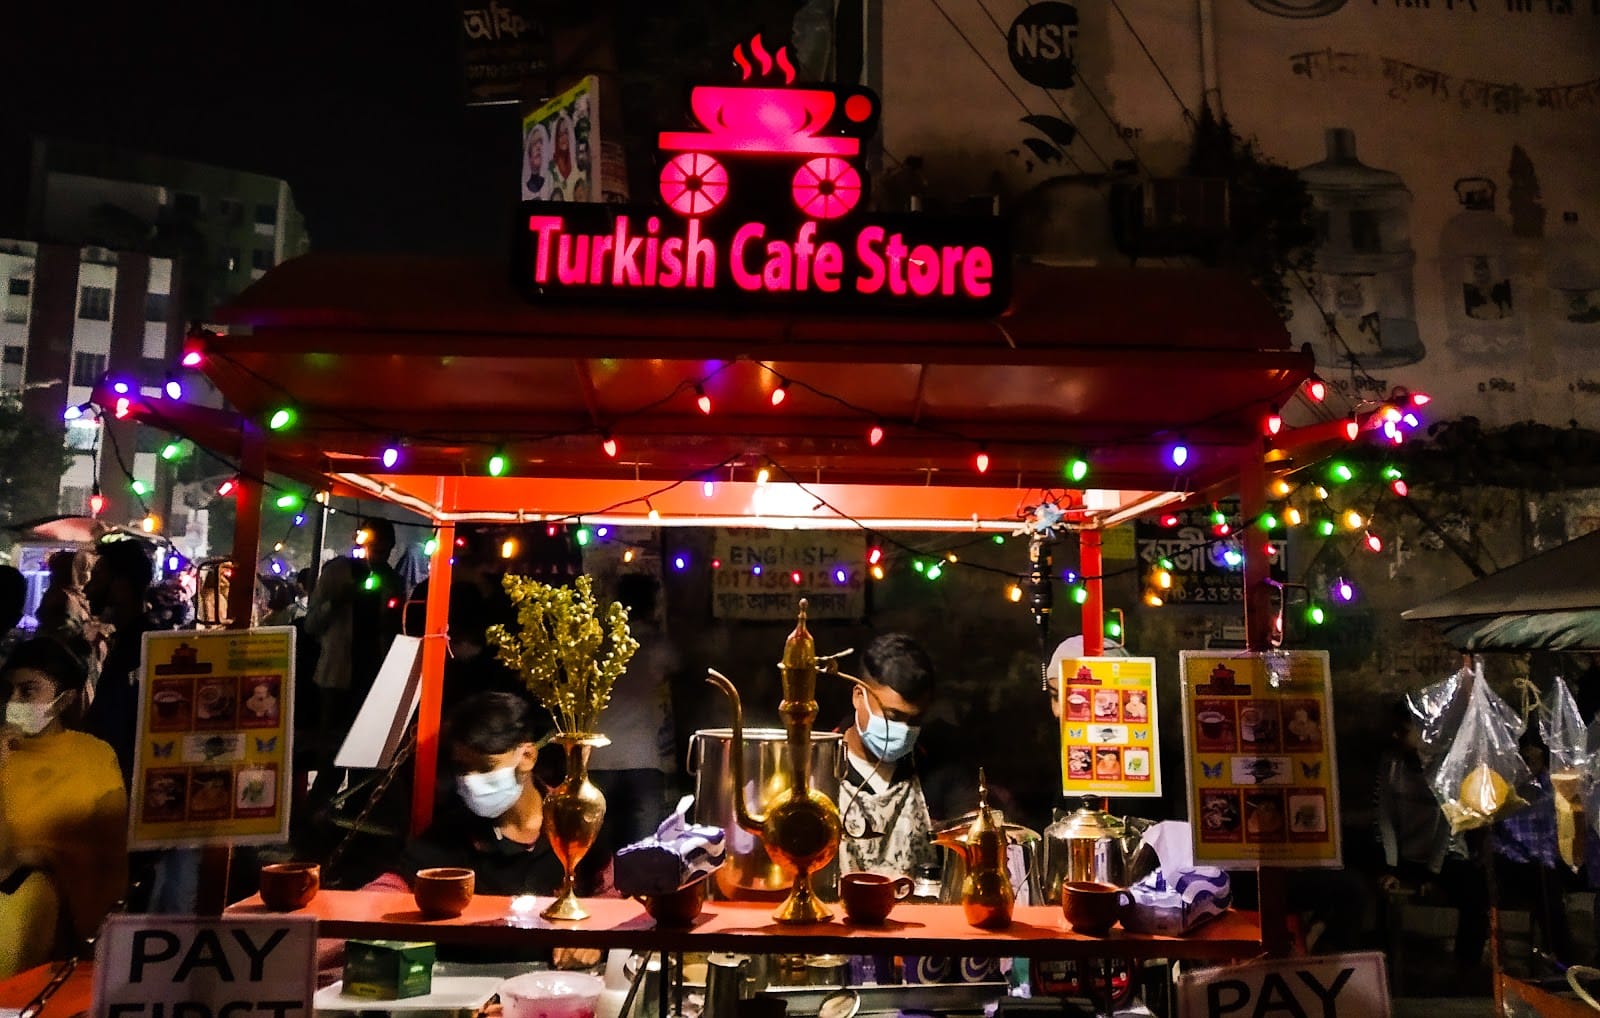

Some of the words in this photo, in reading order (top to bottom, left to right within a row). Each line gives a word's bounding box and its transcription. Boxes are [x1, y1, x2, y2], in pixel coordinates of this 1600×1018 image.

[529, 215, 716, 288] Turkish
[730, 222, 843, 292] Cafe
[856, 225, 993, 298] Store
[129, 928, 290, 983] PAY
[1207, 968, 1355, 1018] PAY
